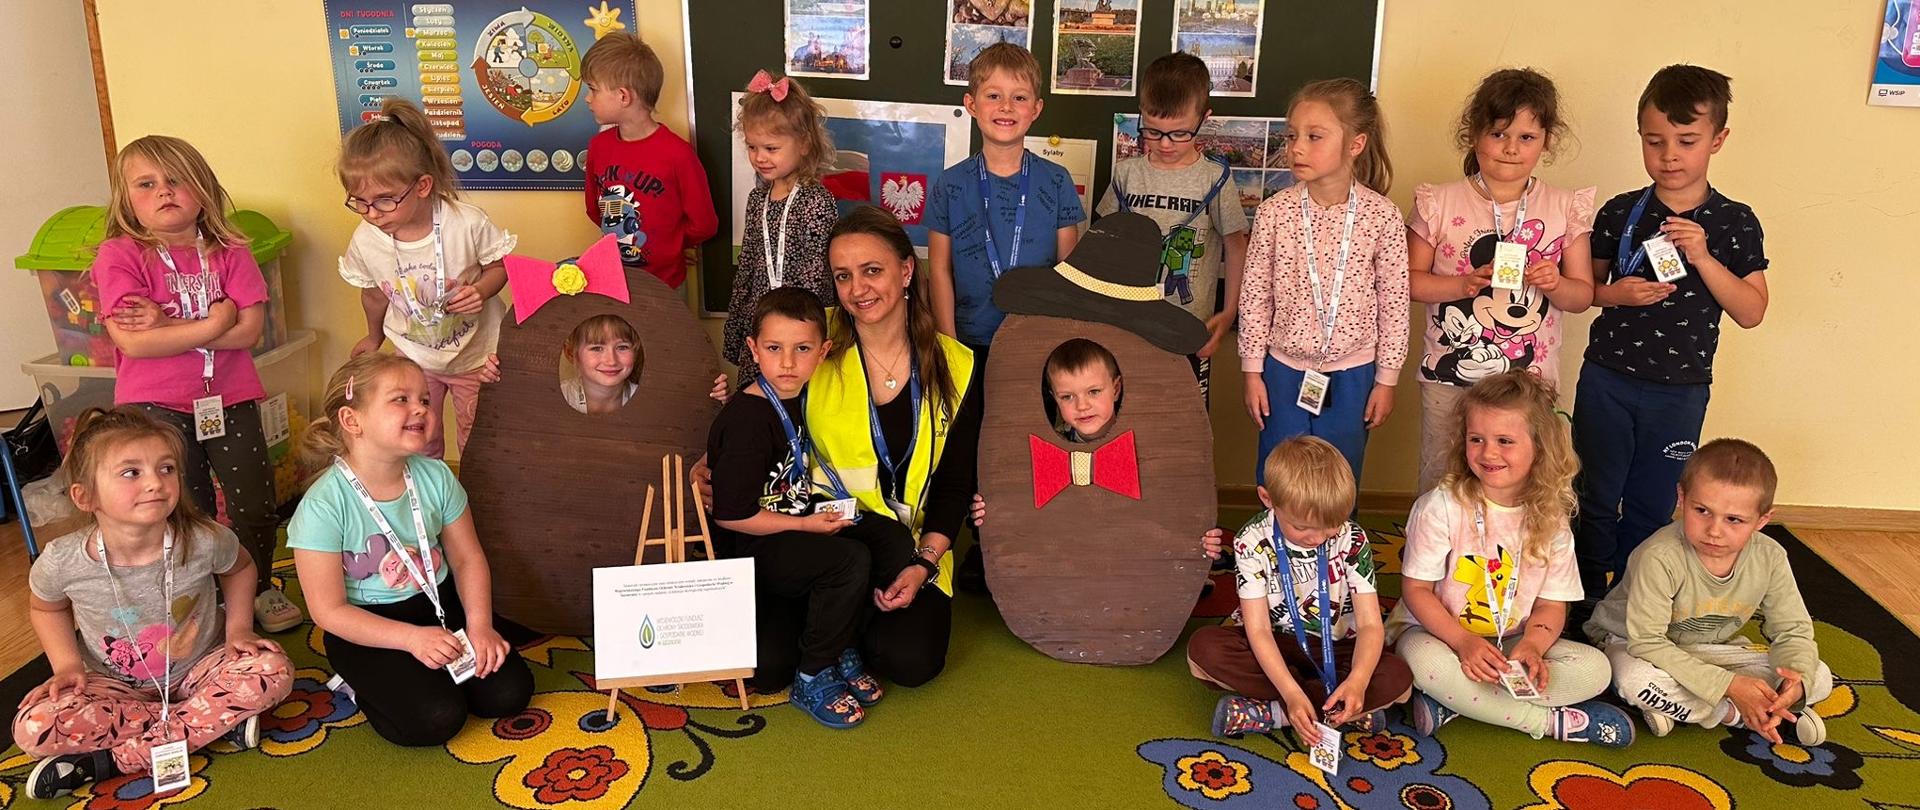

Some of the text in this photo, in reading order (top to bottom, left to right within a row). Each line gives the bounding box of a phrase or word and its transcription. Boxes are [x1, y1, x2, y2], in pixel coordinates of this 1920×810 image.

[488, 20, 506, 37] ZIMA
[547, 22, 575, 53] WIOSNA
[552, 99, 570, 116] LATO
[471, 140, 502, 148] POGODA
[1042, 149, 1064, 157] Sylaby
[1637, 688, 1692, 721] PIKACHU
